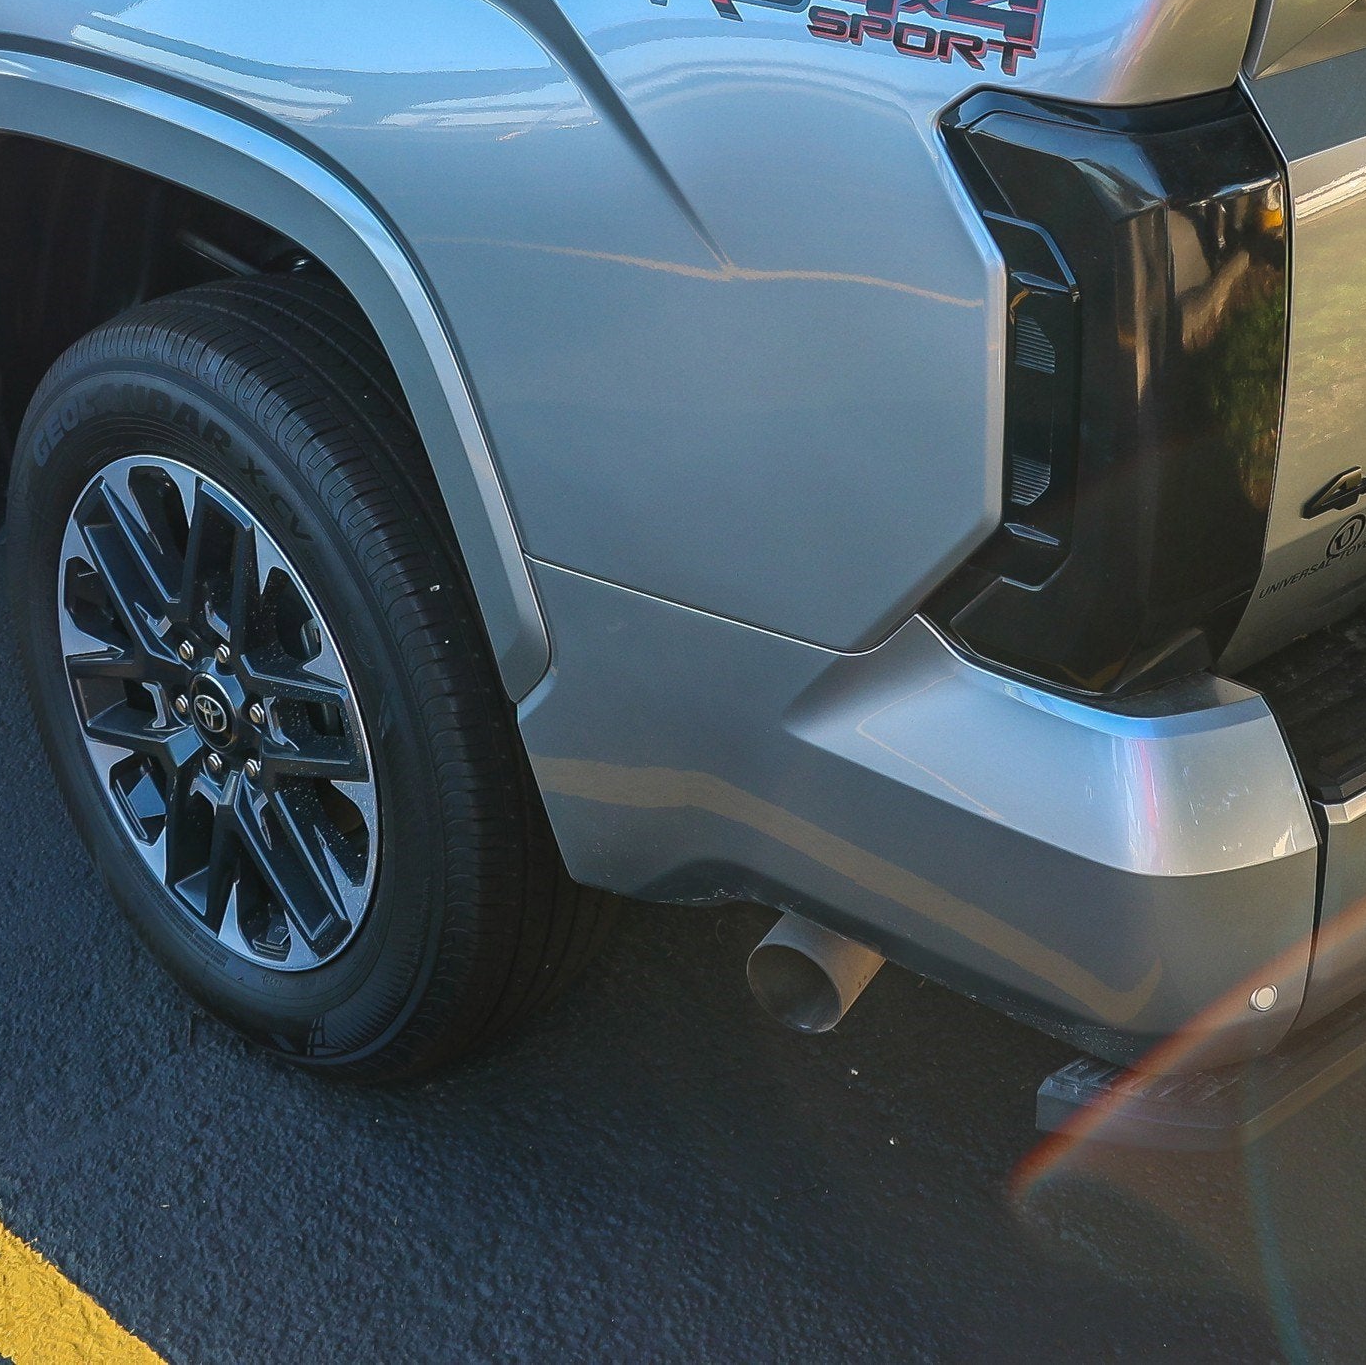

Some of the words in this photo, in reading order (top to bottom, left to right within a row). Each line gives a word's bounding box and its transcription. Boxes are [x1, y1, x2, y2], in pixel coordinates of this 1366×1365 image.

[806, 5, 1037, 77] SPORT
[239, 455, 314, 542] X-CV
[1258, 555, 1335, 599] UNIVERSAL
